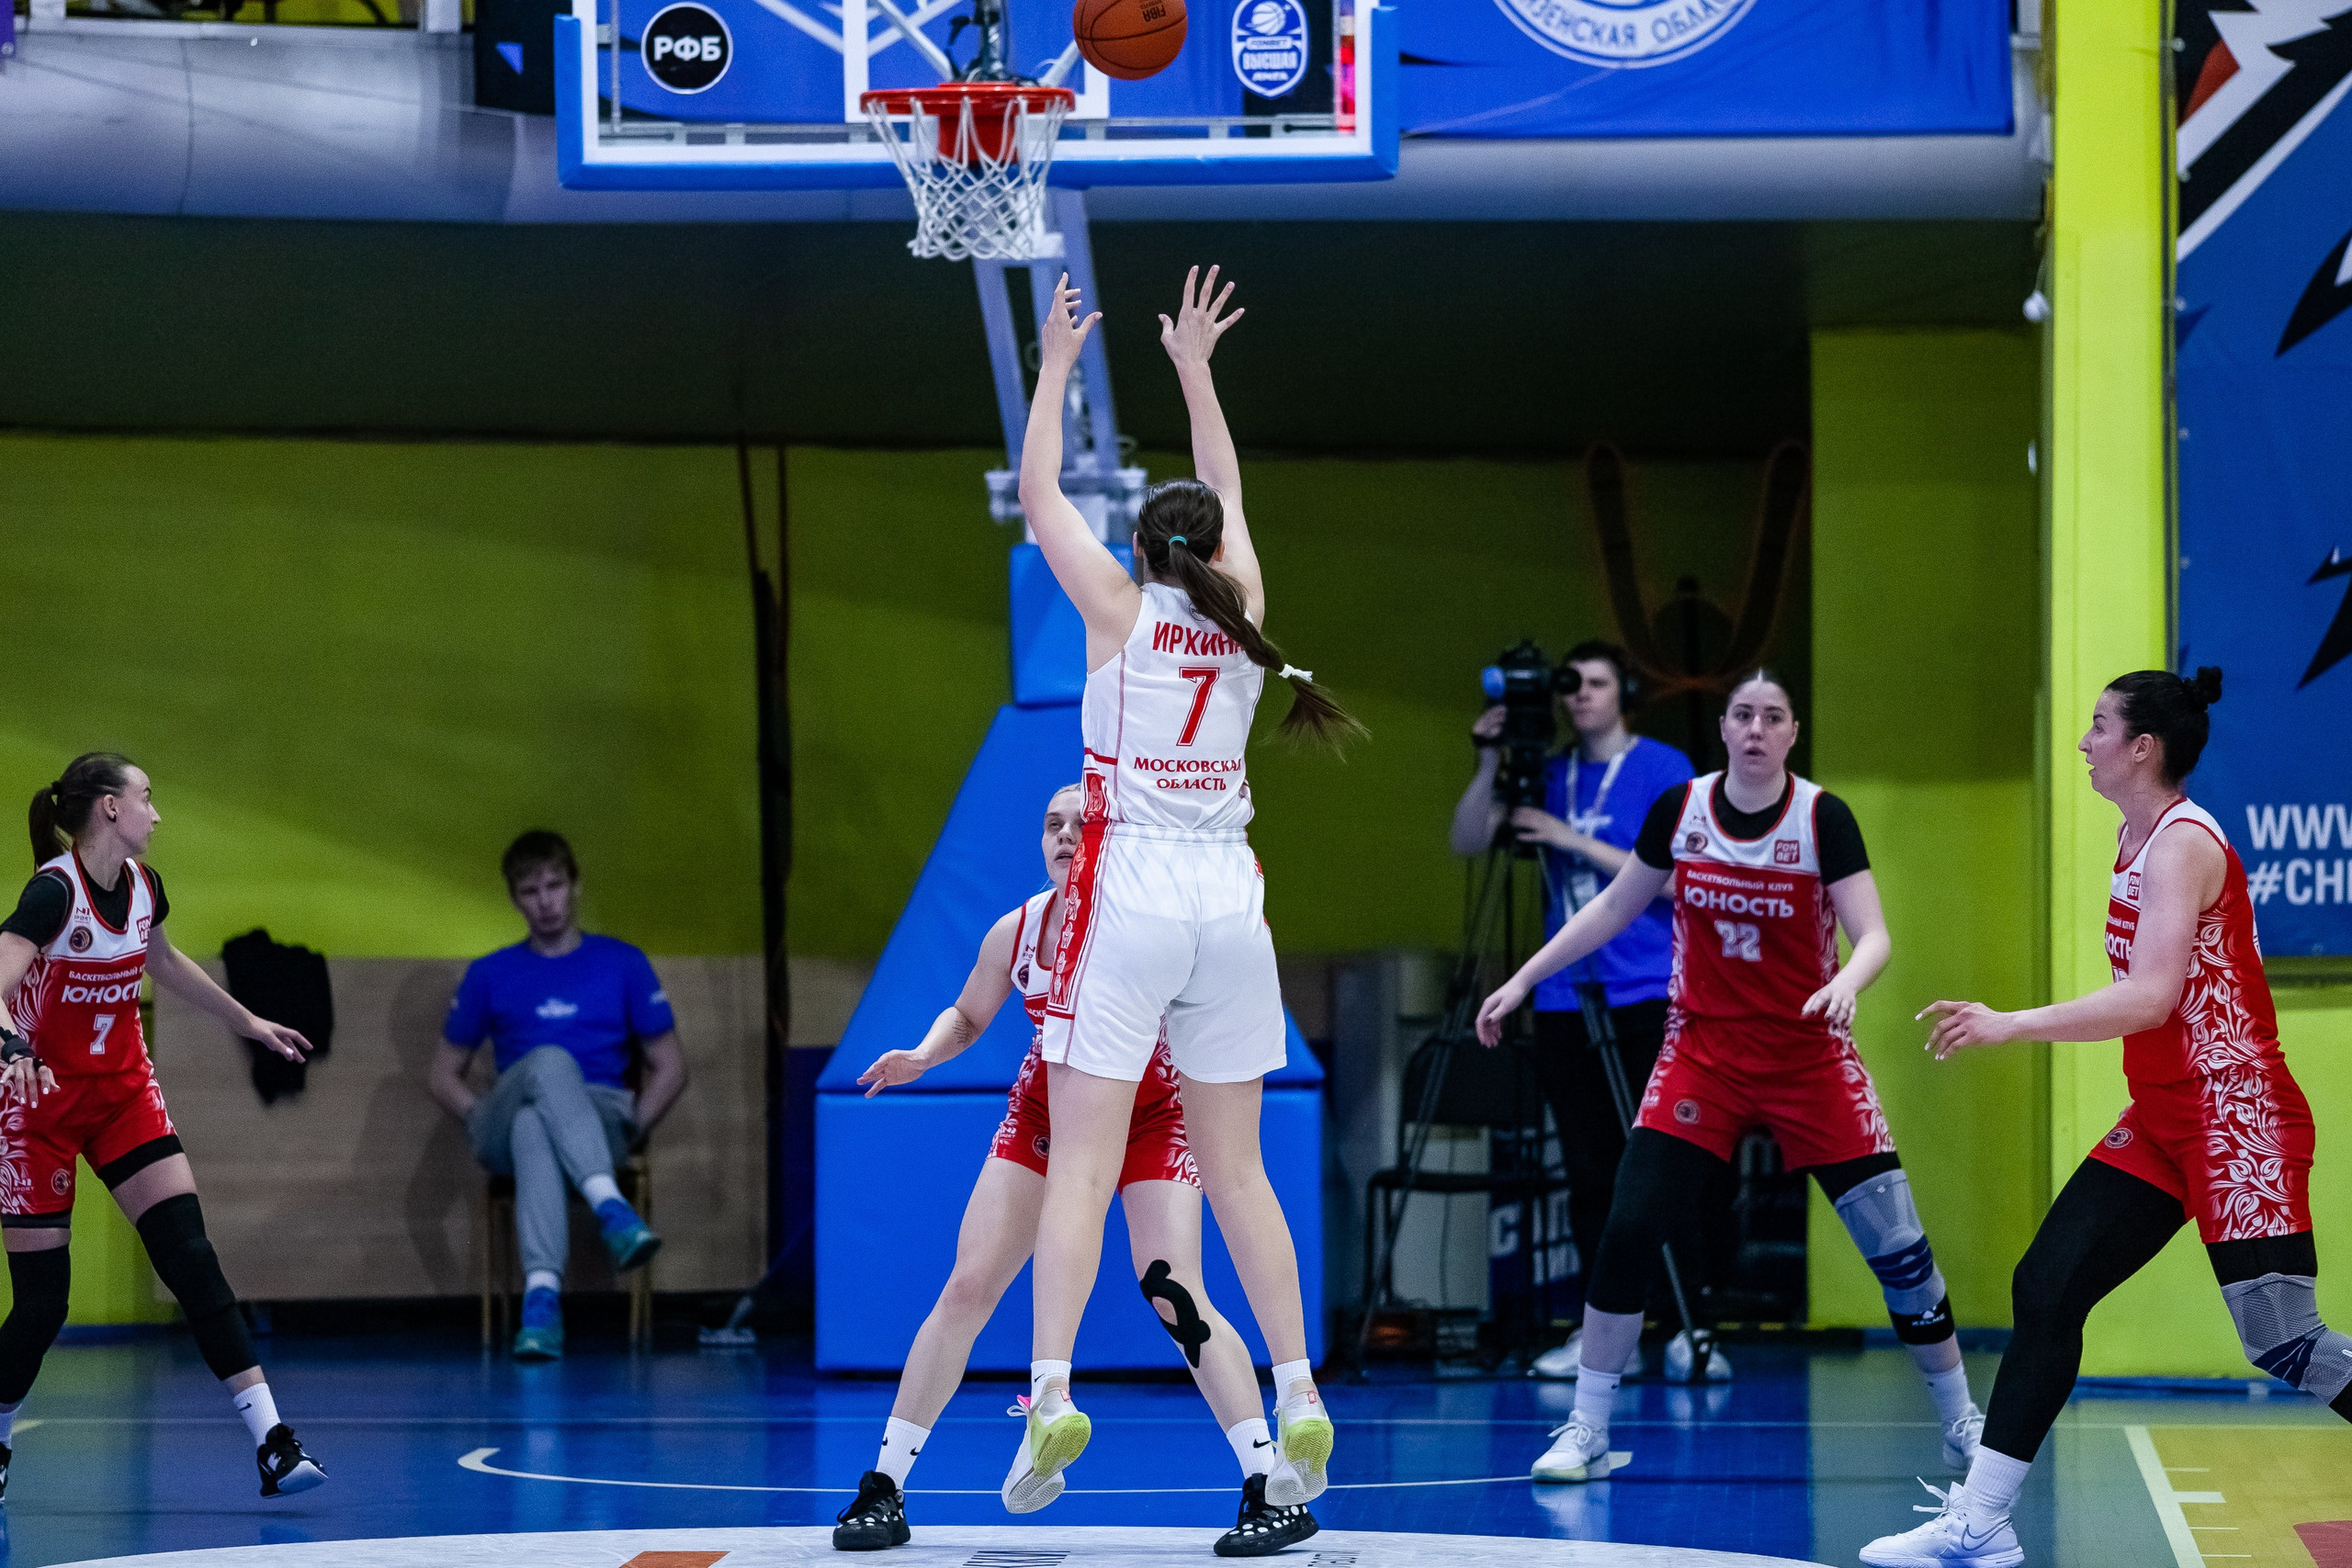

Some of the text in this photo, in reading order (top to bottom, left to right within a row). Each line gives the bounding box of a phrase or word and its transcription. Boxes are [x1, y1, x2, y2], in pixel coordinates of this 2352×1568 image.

[1142, 4, 1167, 22] FIBA
[653, 35, 722, 62] РФБ
[1175, 666, 1220, 747] 7
[1156, 777, 1227, 791] ОБЛАСТЬ
[1684, 884, 1794, 918] ЮНОСТЬ
[68, 966, 138, 982] БАСКЕТБОЛЬНЫЙ
[89, 1013, 116, 1055] 7
